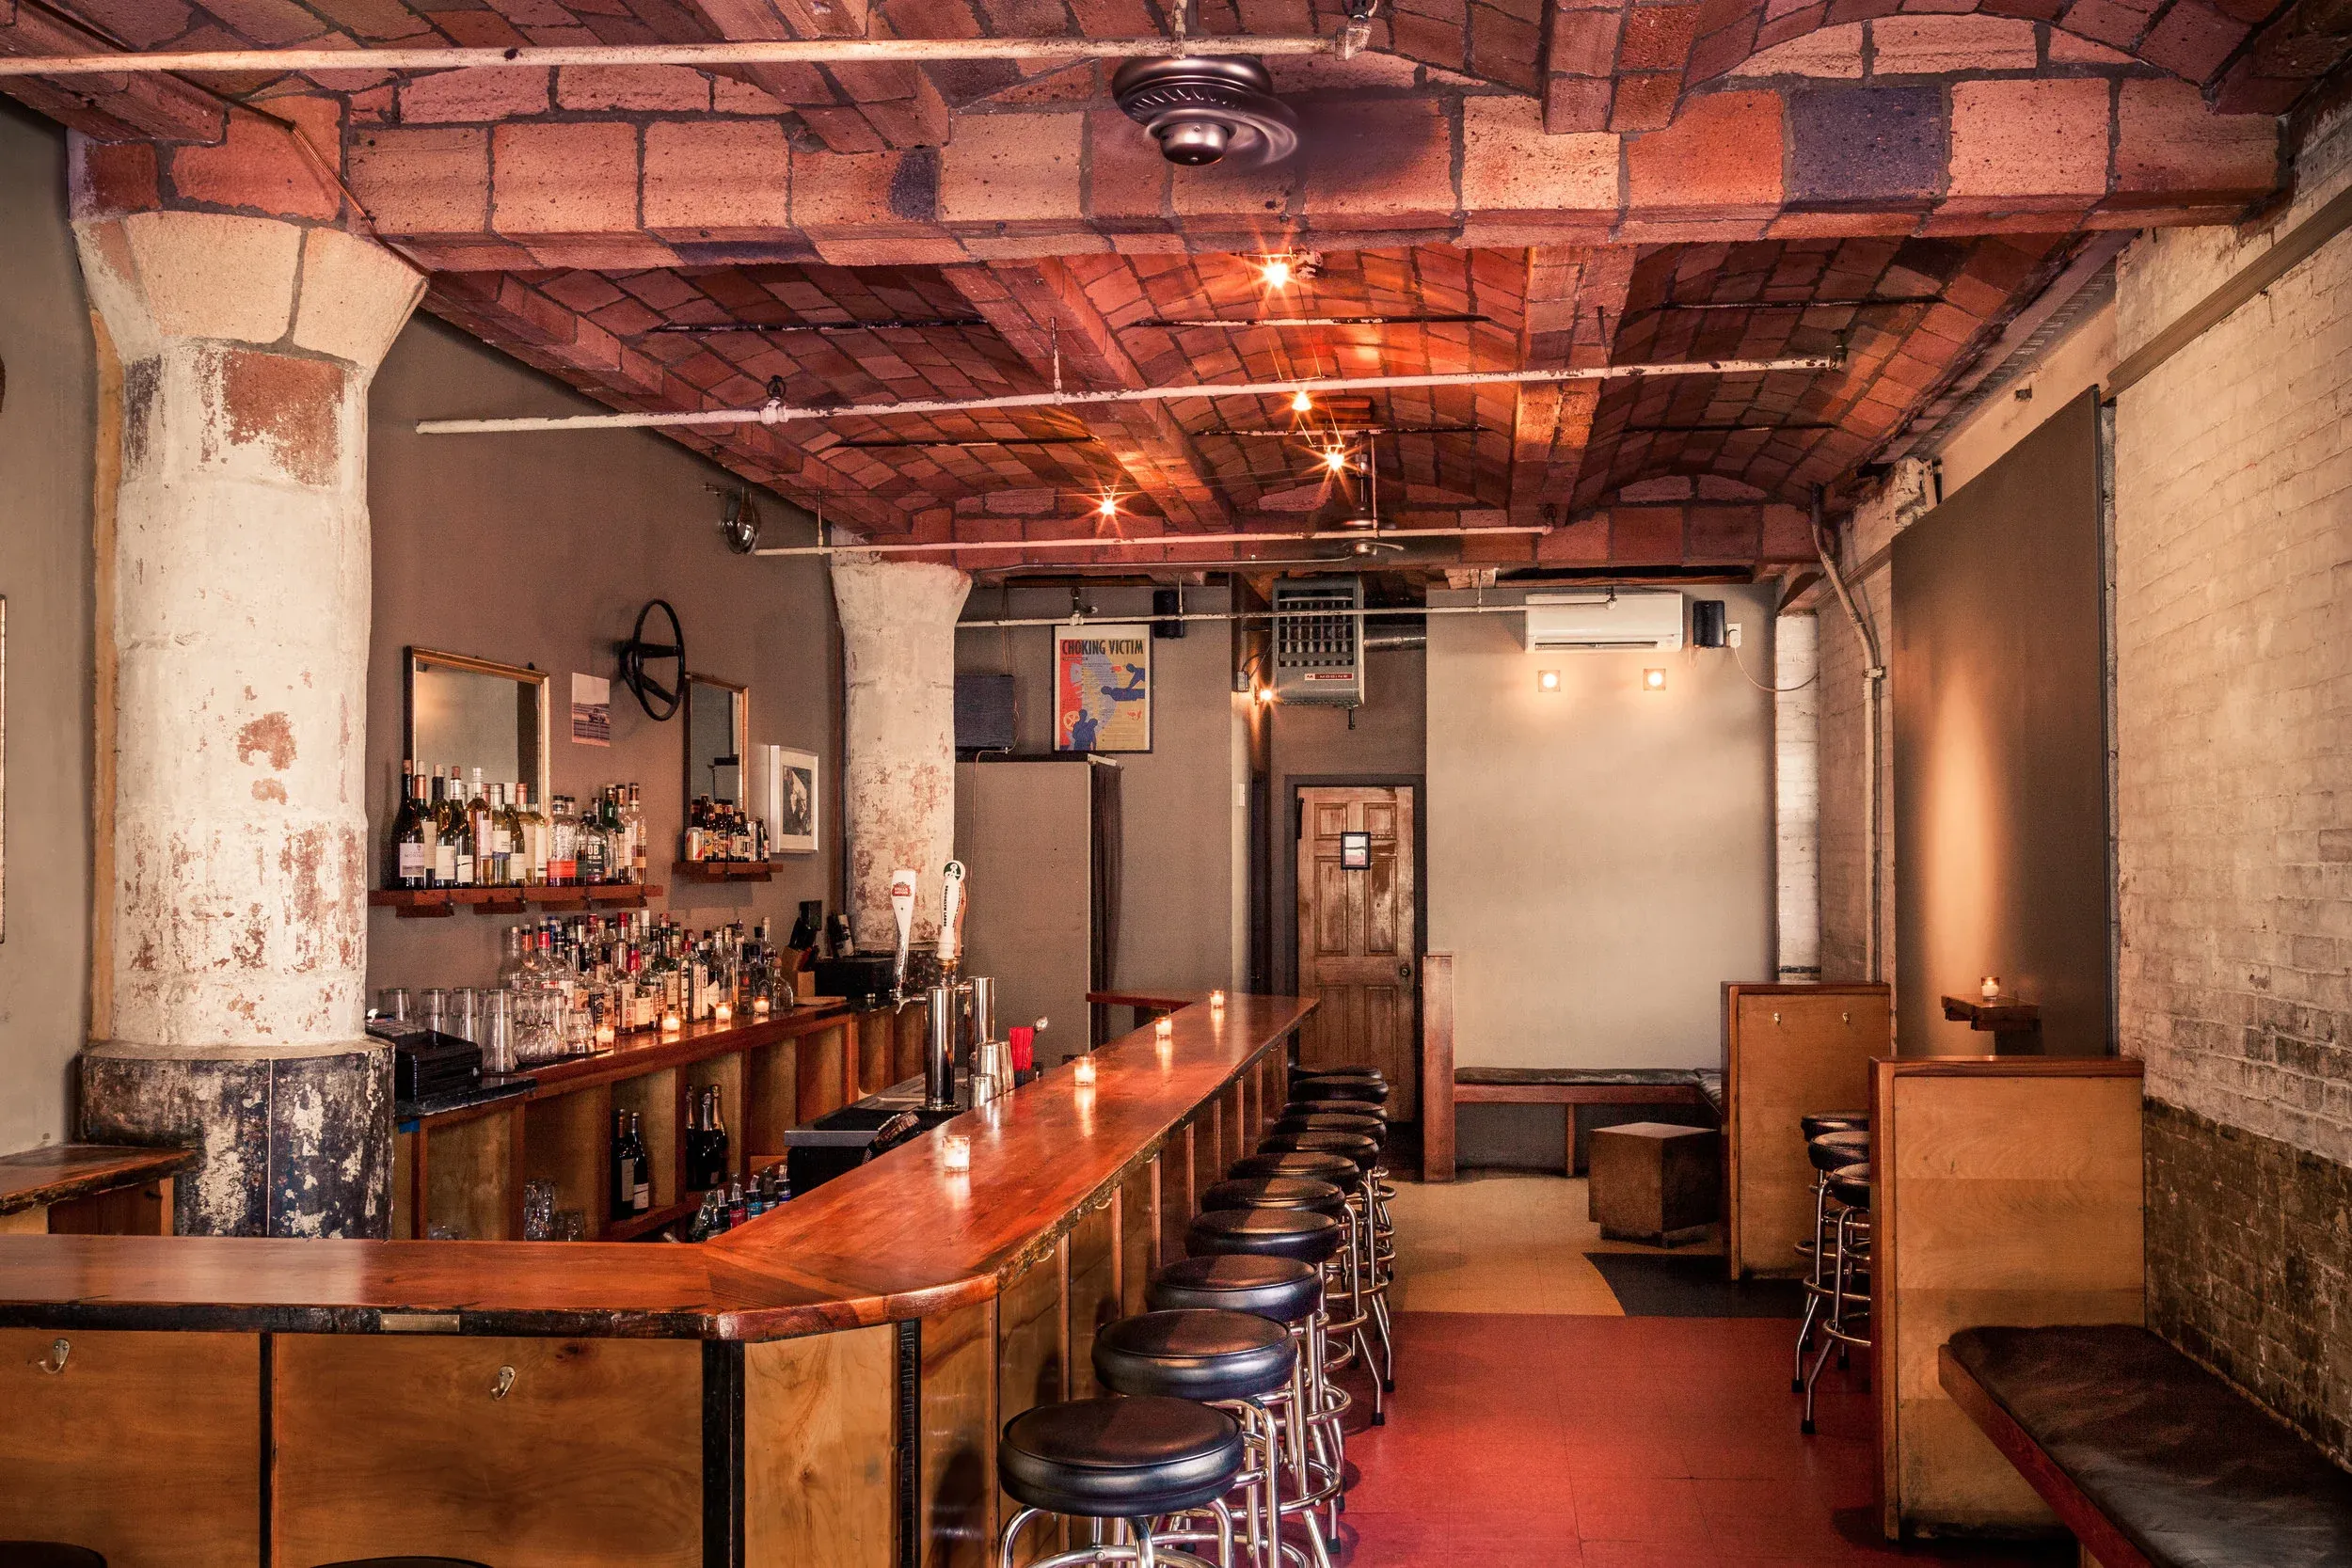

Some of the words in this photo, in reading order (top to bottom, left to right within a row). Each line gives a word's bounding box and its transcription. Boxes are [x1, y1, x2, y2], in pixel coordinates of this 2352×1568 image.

[1062, 641, 1105, 655] CHOKING
[1108, 641, 1144, 655] VICTIM
[587, 845, 599, 855] OB
